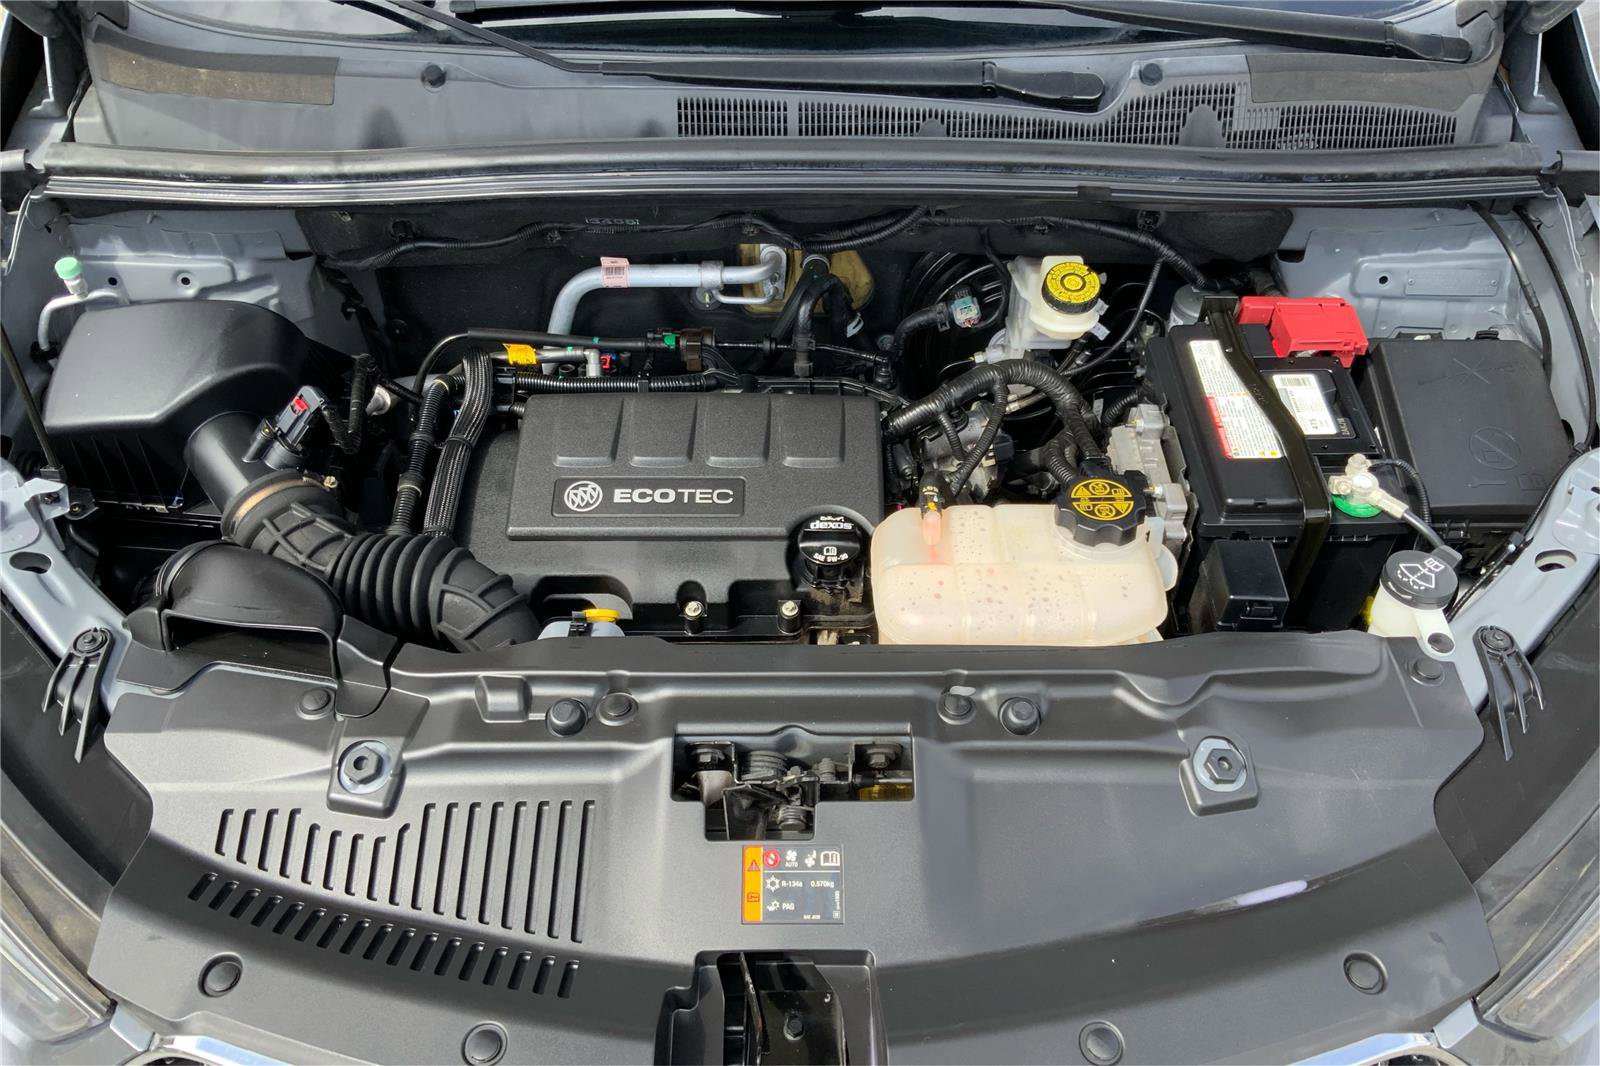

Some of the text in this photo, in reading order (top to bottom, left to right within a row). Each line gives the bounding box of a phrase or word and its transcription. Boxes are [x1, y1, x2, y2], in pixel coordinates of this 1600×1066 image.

[613, 488, 734, 504] ECOTEC
[810, 520, 852, 529] dexos
[782, 902, 795, 910] PAG
